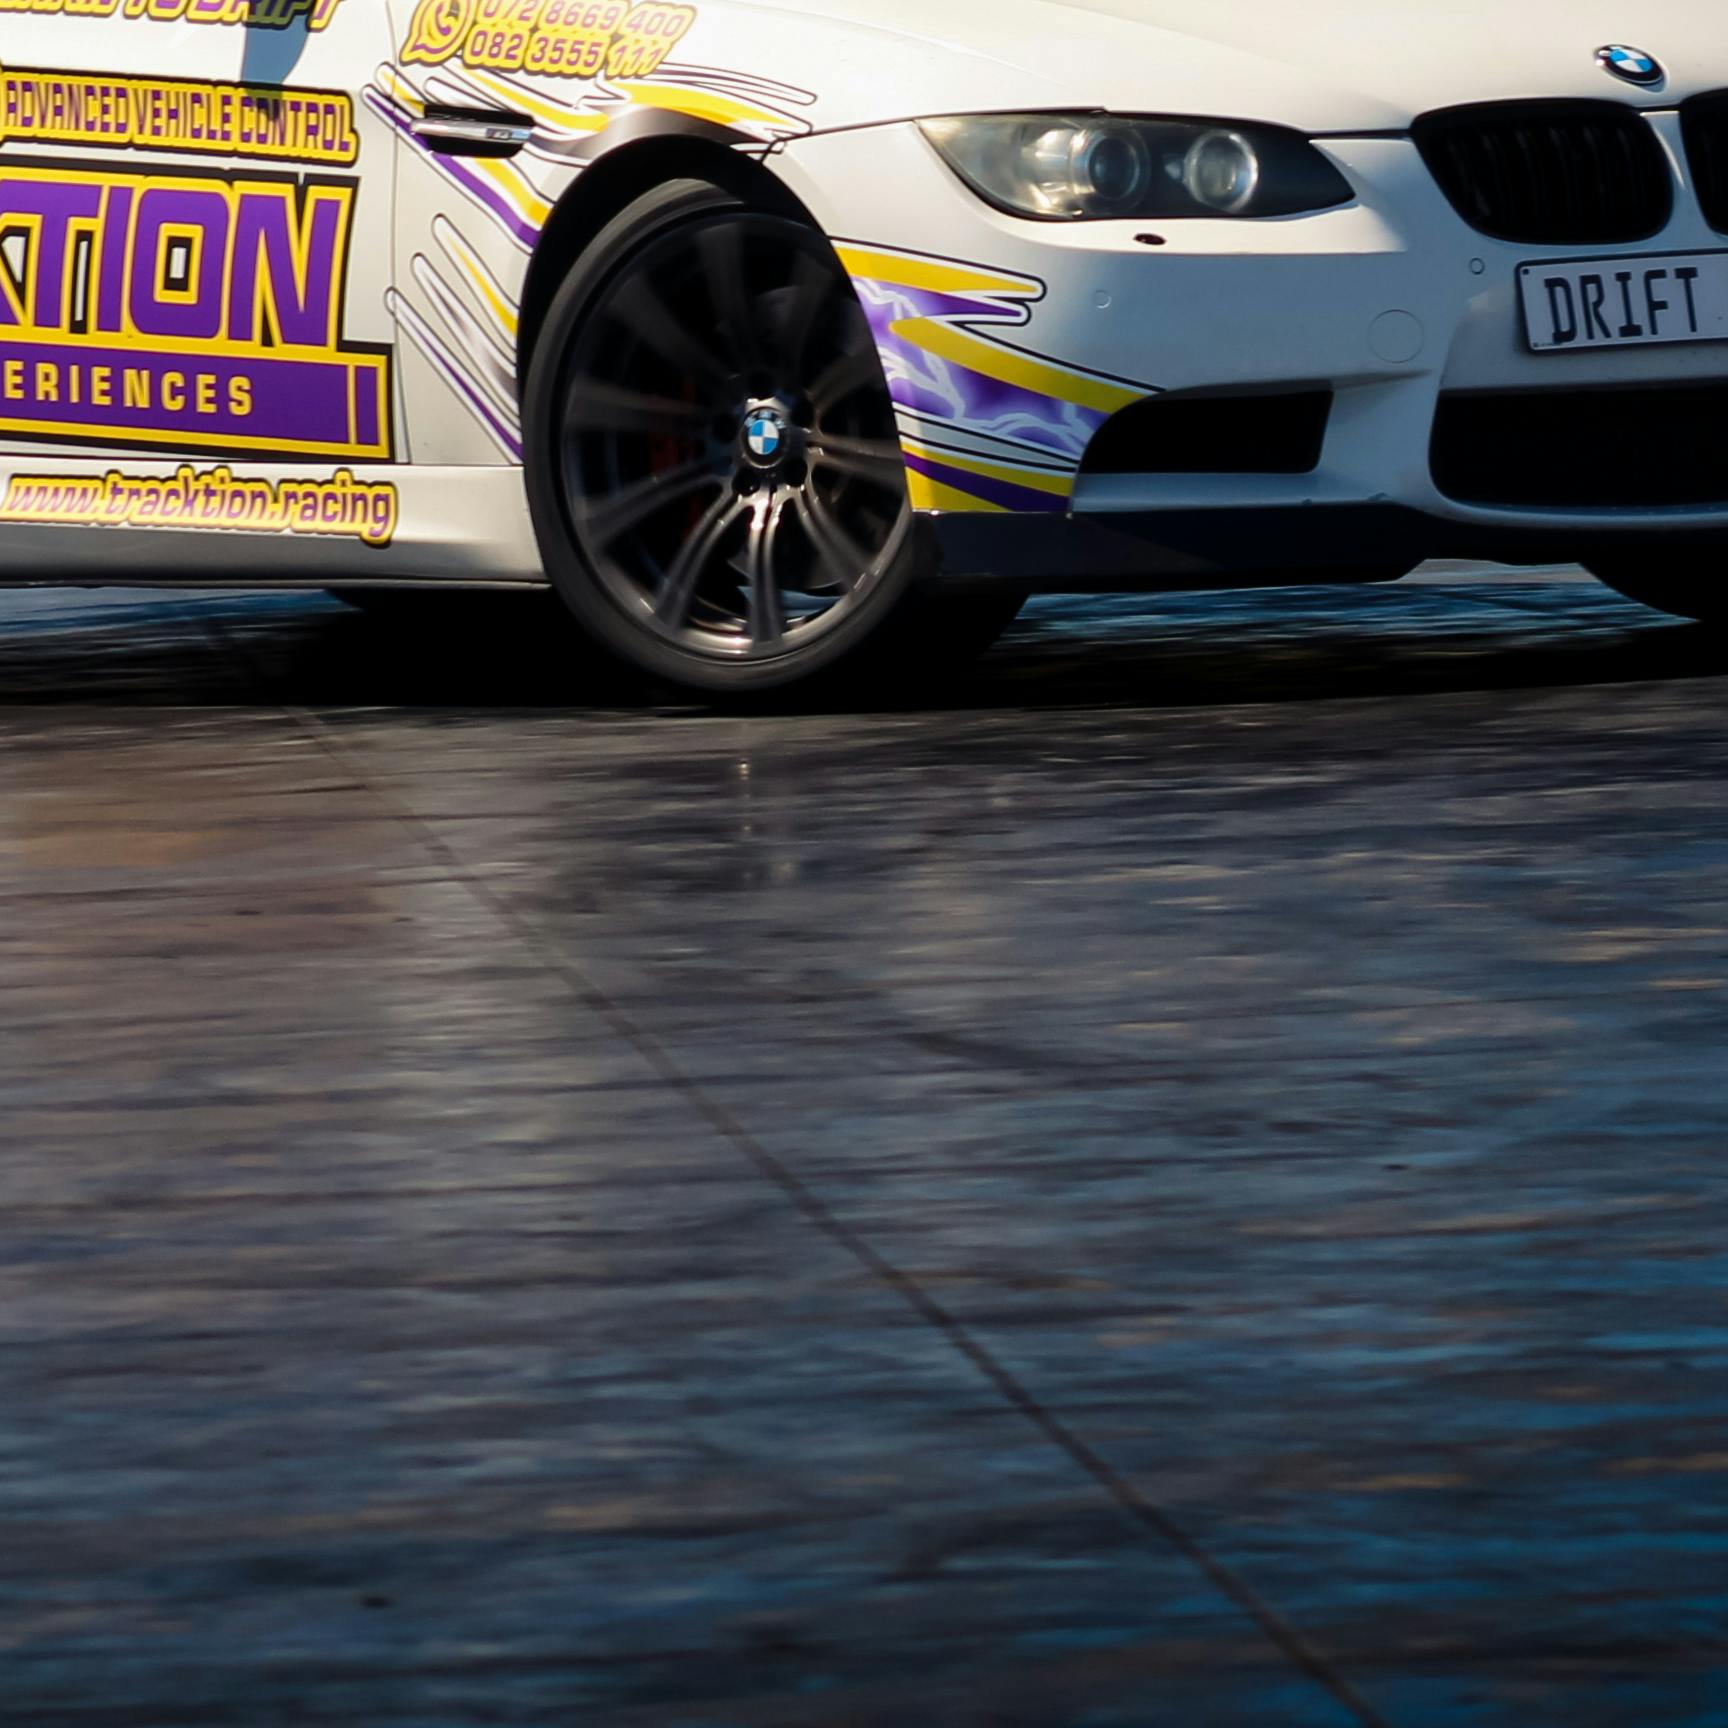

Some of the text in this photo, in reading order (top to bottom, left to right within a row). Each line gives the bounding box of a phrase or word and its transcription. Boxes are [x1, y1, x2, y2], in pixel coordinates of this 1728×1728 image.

[471, 29, 664, 71] 082 3555 111
[544, 0, 621, 31] 8669
[625, 8, 686, 38] 400
[5, 78, 128, 134] ADVANCED
[131, 87, 233, 142] VEHICLE
[239, 94, 352, 154] CONTROL
[1544, 266, 1700, 344] DRIFT
[7, 472, 393, 538] www.tracktion.racing
